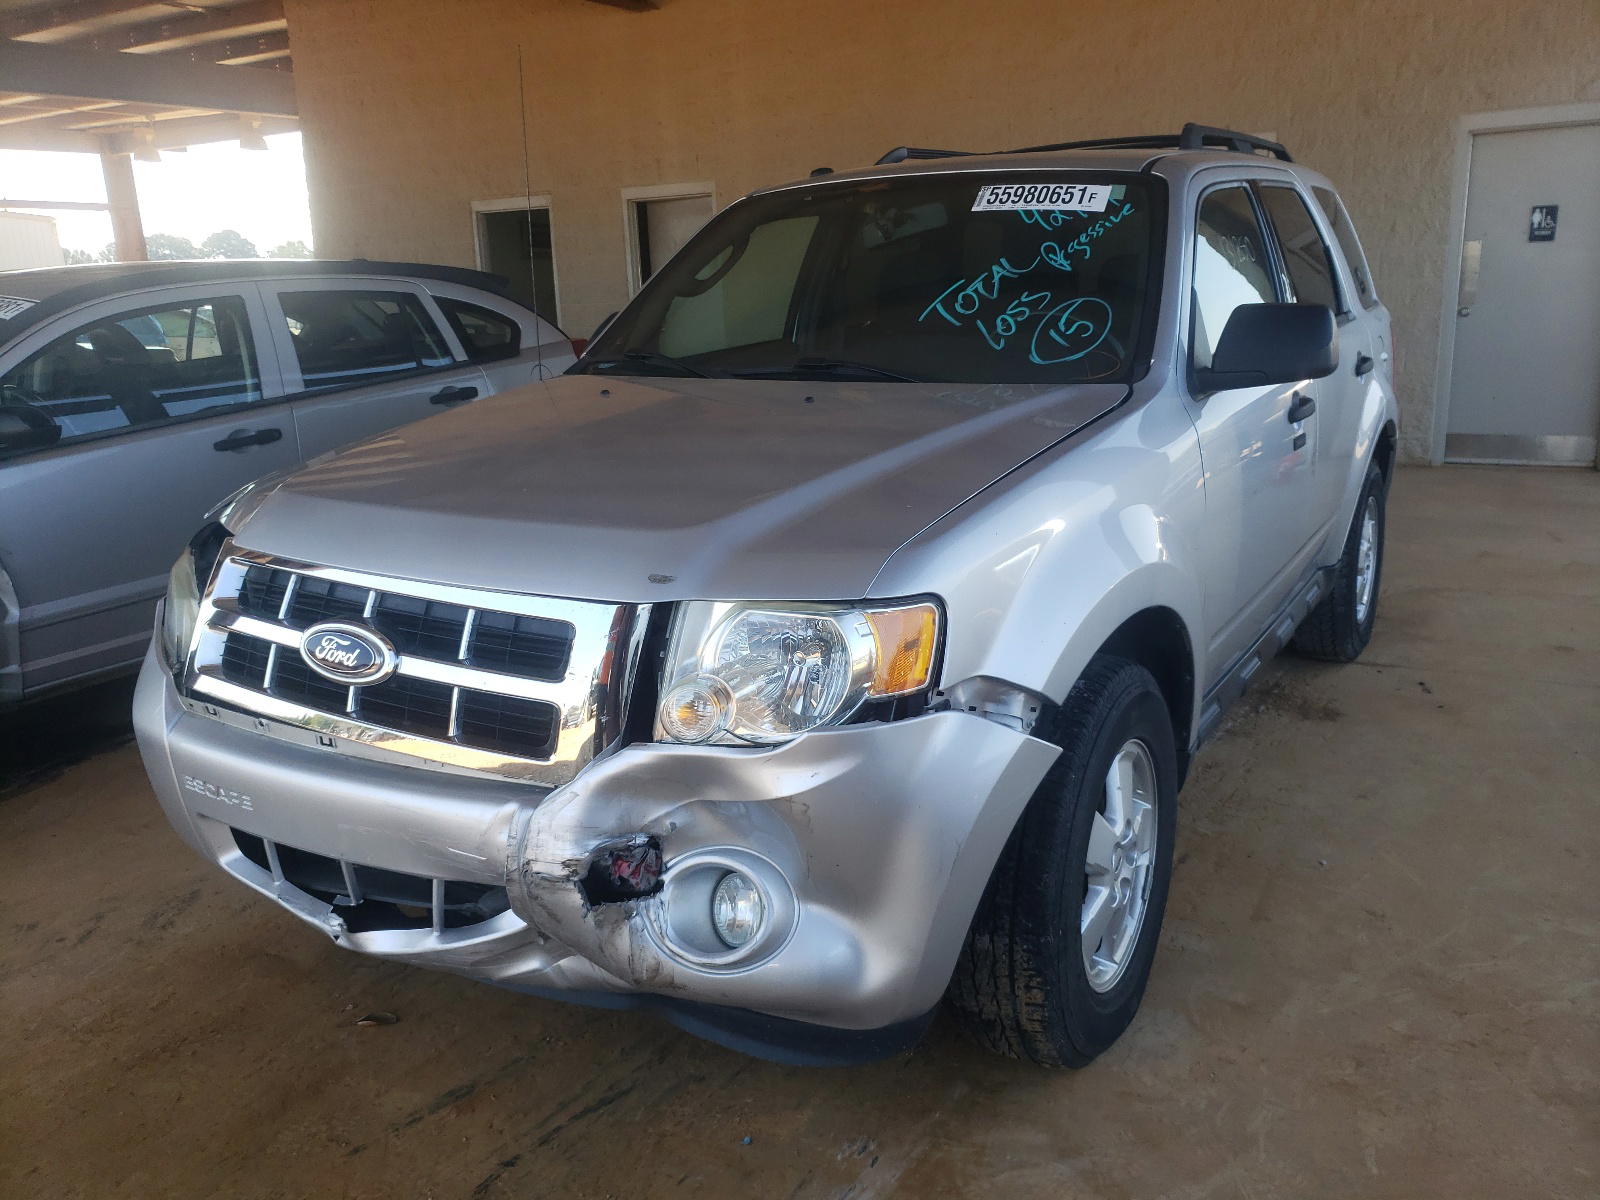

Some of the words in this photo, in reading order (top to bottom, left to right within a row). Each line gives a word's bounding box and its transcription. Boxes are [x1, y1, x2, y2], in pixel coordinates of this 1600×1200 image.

[918, 257, 1041, 326] TOTAL
[1048, 299, 1094, 347] 15
[315, 635, 361, 667] Ford
